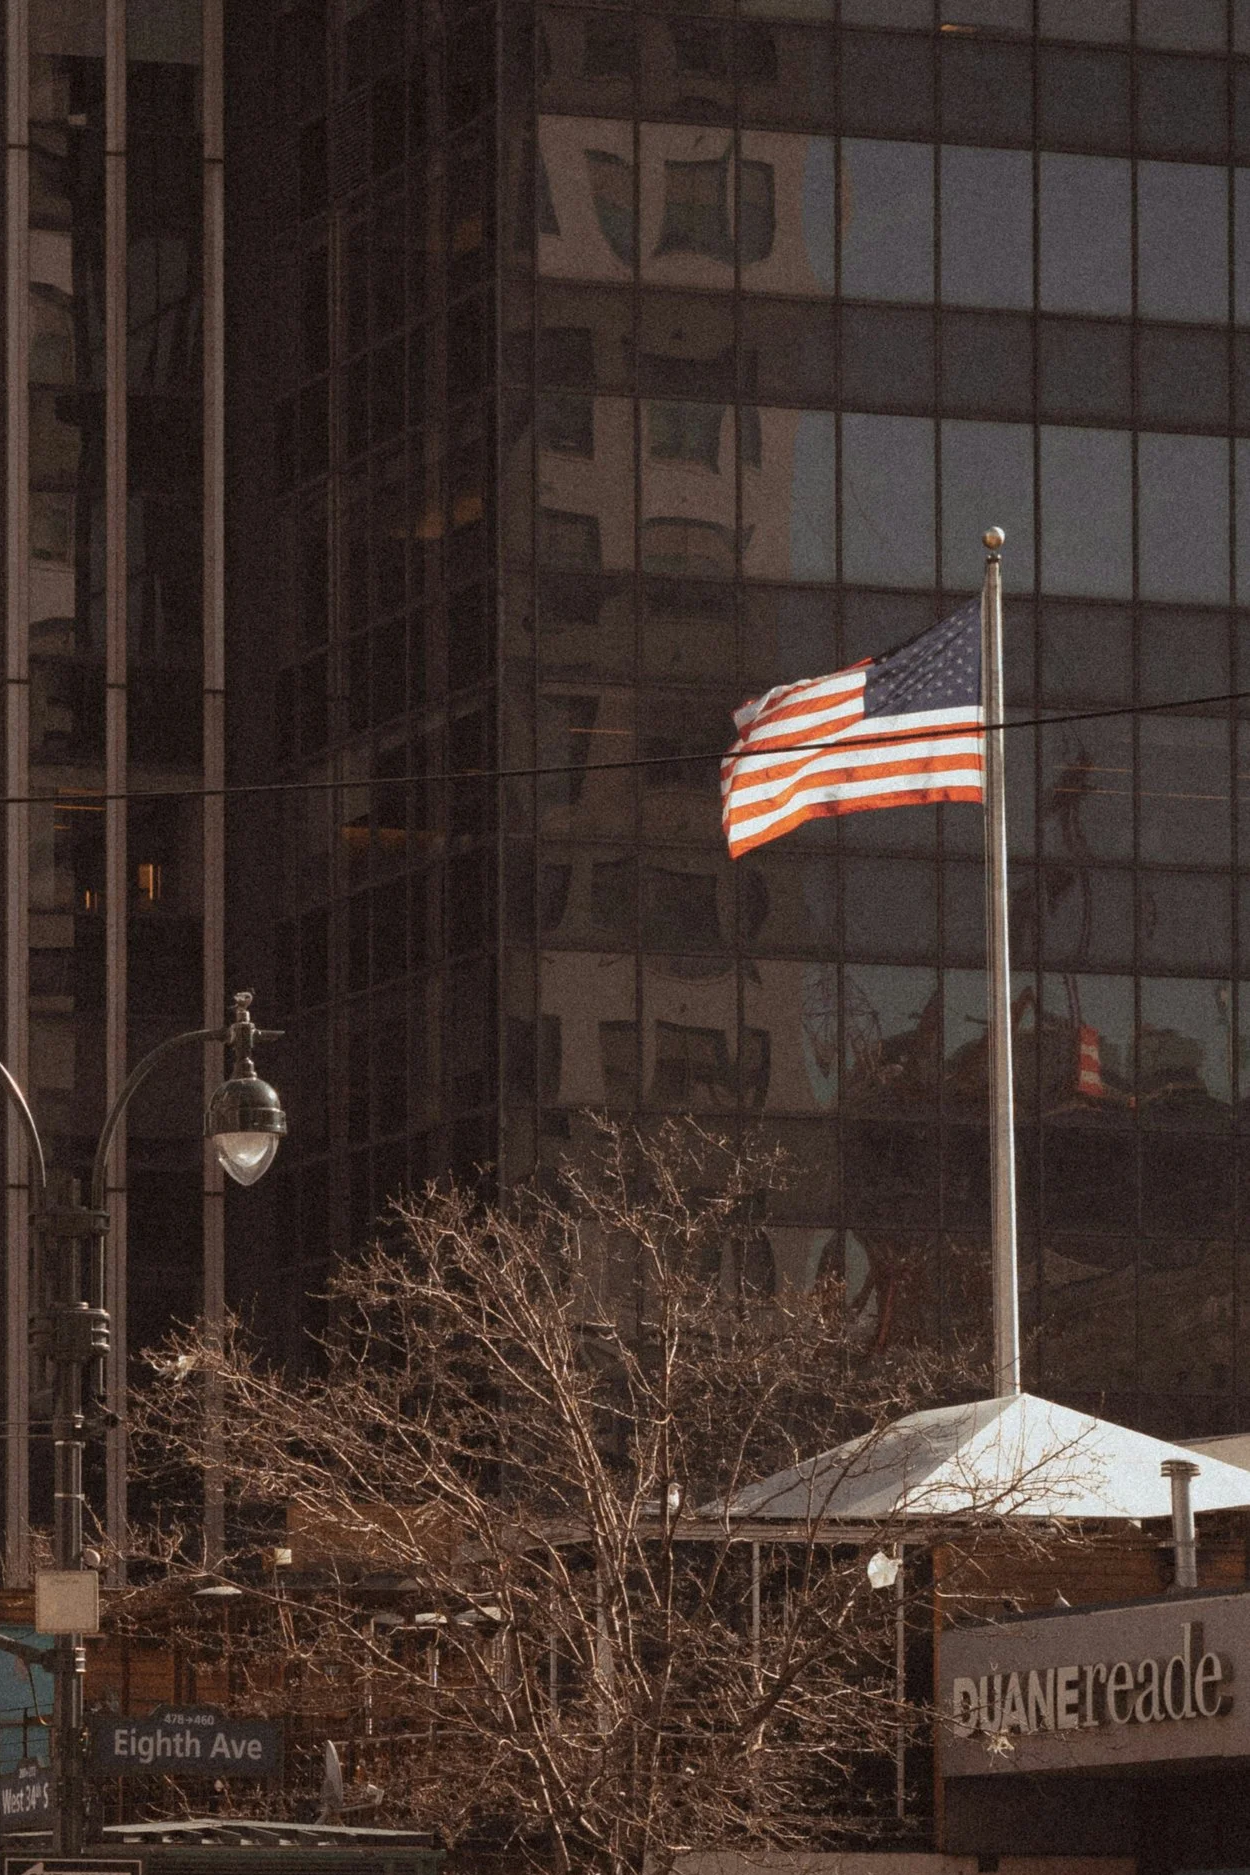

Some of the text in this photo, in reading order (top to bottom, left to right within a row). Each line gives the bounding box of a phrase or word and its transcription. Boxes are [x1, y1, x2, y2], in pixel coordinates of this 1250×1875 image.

[113, 1729, 263, 1764] Eighth Ave
[1, 1788, 25, 1816] West
[43, 1781, 49, 1809] S
